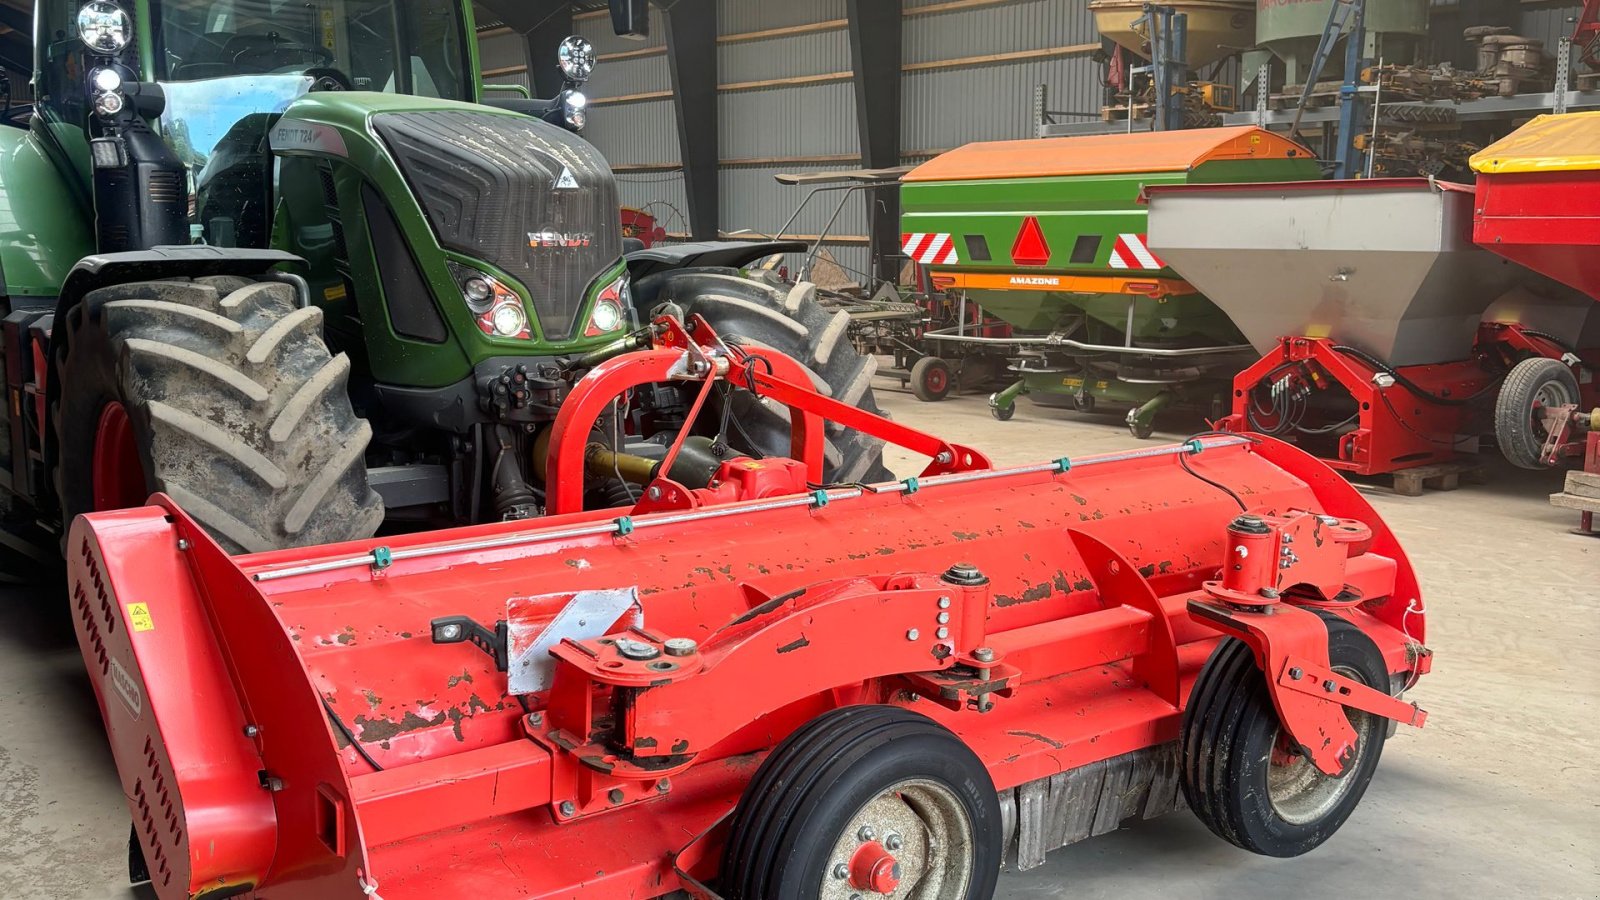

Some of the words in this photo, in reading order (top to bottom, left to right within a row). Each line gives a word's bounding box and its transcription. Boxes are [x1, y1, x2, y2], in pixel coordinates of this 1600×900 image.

[277, 128, 299, 142] FENDT
[300, 129, 313, 143] 724
[527, 231, 594, 248] FENDT
[1009, 276, 1060, 286] AMAZONE
